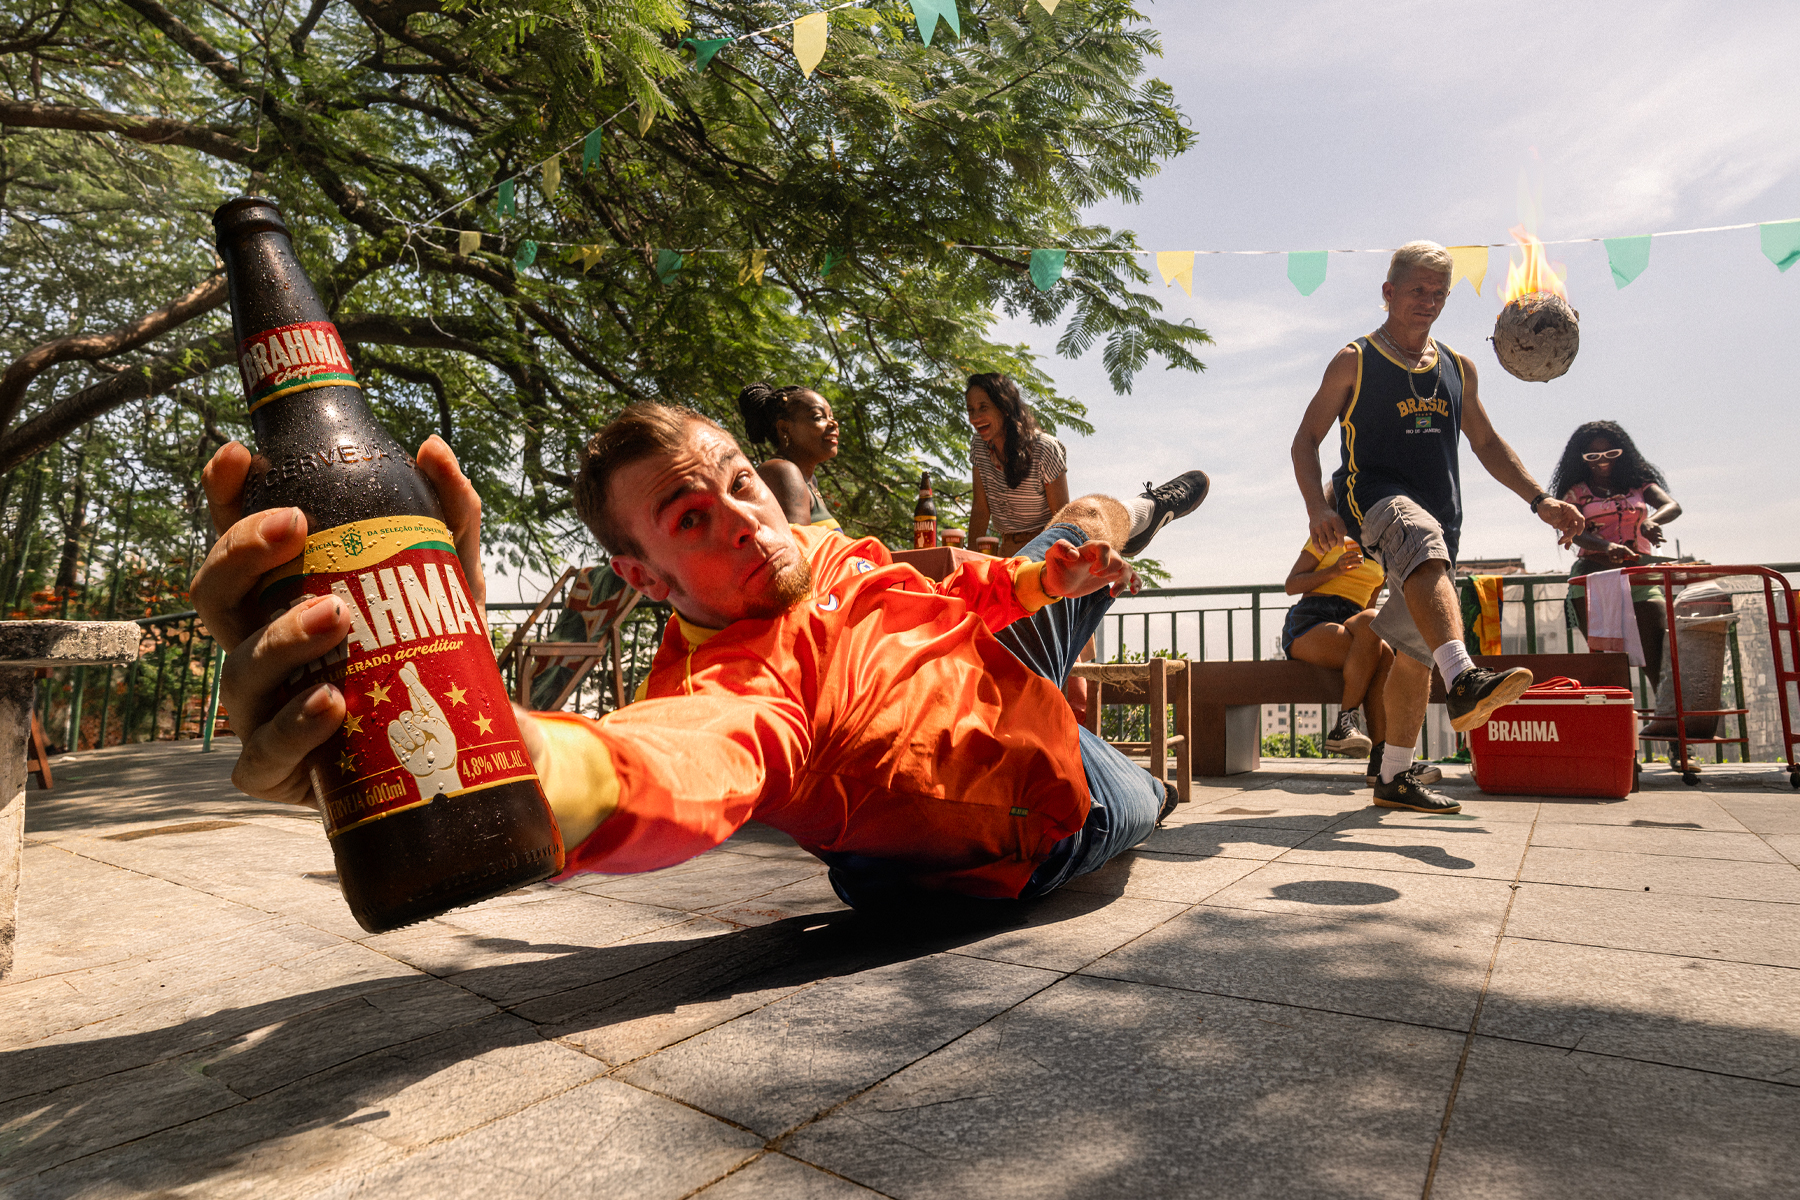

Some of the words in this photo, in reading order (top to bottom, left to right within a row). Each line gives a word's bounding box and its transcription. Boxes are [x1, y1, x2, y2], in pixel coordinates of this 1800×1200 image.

[241, 329, 348, 389] BRAHMA
[1396, 397, 1449, 417] BRASIL
[265, 443, 396, 487] CERVEJA
[367, 529, 380, 537] DA
[381, 525, 413, 535] SELEÇÃO
[305, 540, 337, 556] OFICIAL
[327, 654, 392, 683] LIBERADO
[394, 639, 464, 661] acreditar
[1487, 720, 1560, 742] BRAHMA
[462, 755, 493, 781] 4,8%
[366, 776, 408, 807] 600ml
